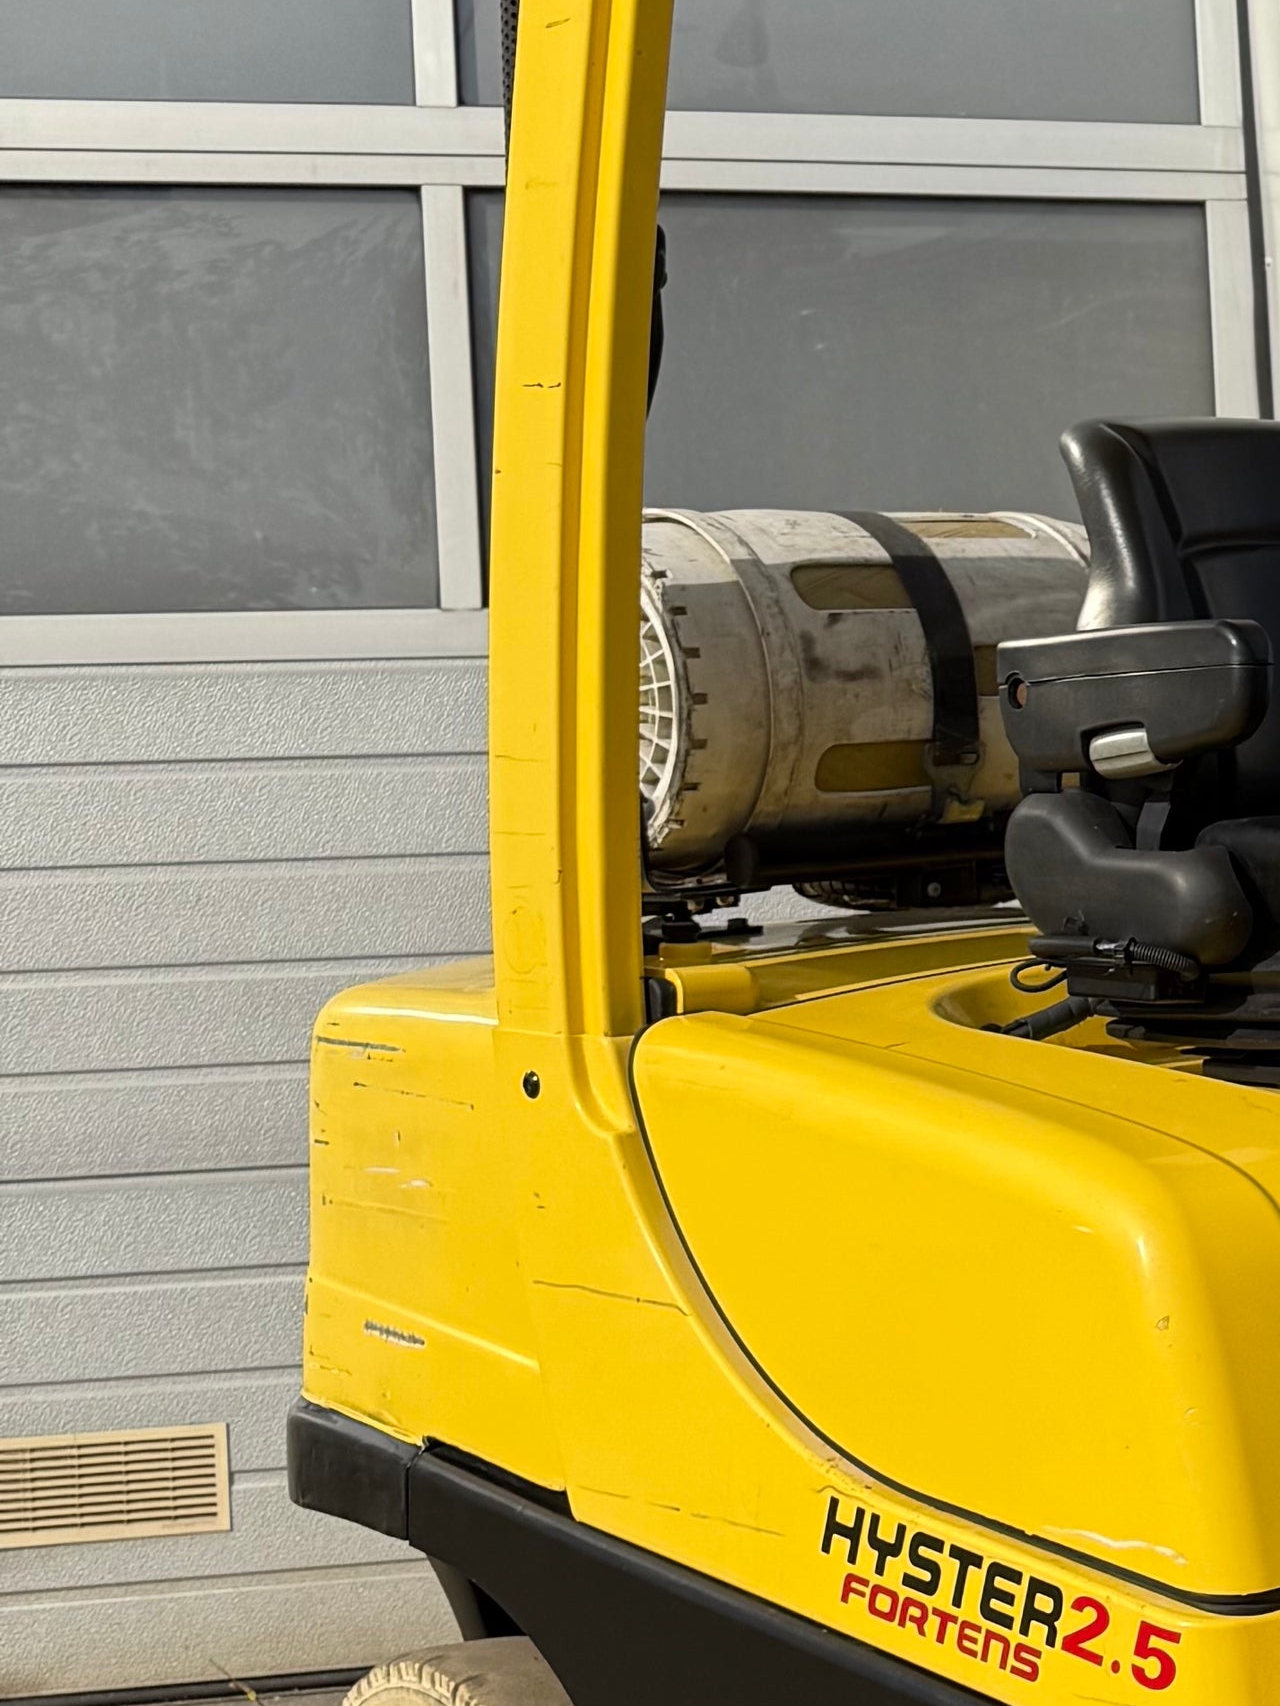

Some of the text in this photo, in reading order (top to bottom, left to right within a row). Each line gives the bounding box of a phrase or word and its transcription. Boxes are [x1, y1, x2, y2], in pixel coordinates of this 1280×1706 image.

[820, 1496, 1182, 1690] HYSTER 2.5
[840, 1572, 1042, 1683] FORTENS
